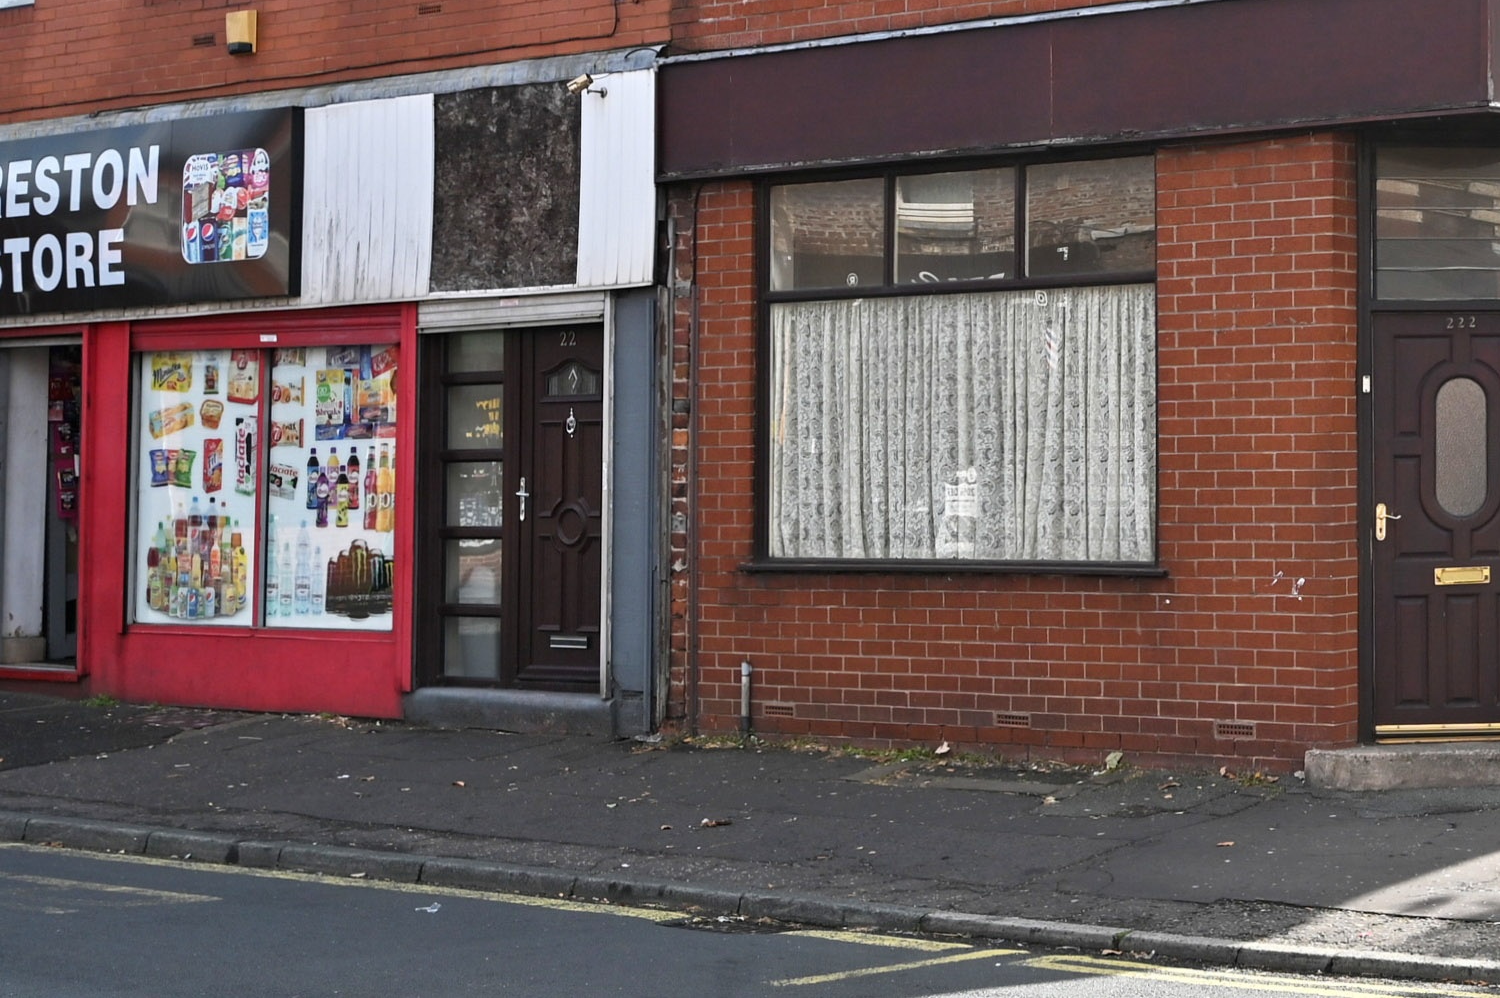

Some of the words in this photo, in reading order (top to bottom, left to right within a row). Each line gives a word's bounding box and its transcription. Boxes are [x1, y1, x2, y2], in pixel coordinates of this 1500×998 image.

[0, 145, 160, 218] ESTON
[0, 228, 125, 293] TORE
[1446, 316, 1476, 329] 222
